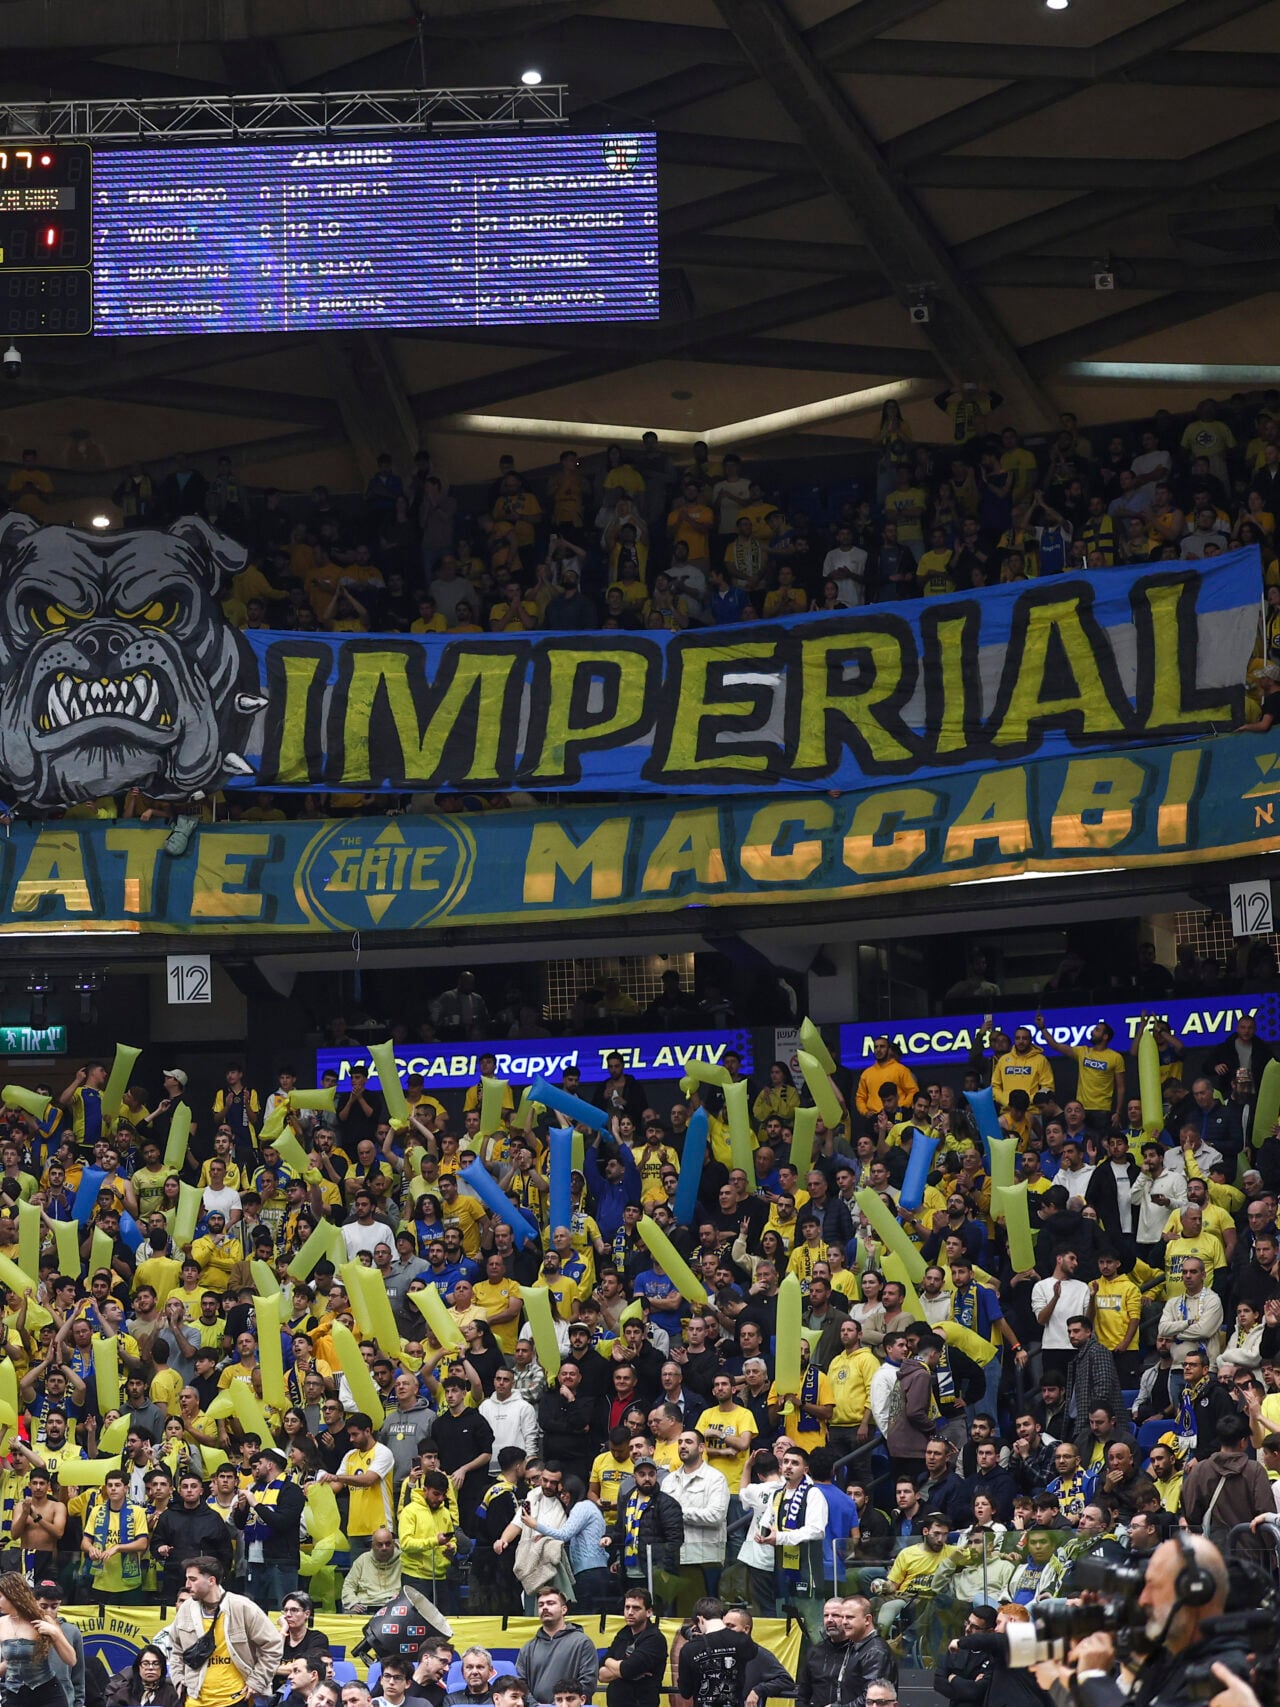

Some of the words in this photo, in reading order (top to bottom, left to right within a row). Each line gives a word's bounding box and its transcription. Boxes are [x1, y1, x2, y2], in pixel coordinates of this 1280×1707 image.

[97, 229, 109, 244] 7
[288, 222, 309, 238] 12
[318, 222, 341, 237] LO
[276, 584, 1236, 788] IMPERIAL
[523, 748, 1202, 903] MACCABI
[340, 837, 362, 846] THE
[323, 846, 448, 892] GATE
[1233, 891, 1272, 933] 12
[169, 965, 209, 1001] 12
[21, 1028, 62, 1051] יציאה
[493, 1050, 579, 1078] Rapyd
[652, 1043, 728, 1068] AVIV
[1006, 1066, 1029, 1075] FOX
[1084, 1058, 1106, 1070] FOX
[47, 1458, 58, 1470] 10
[109, 1618, 141, 1640] ARMY
